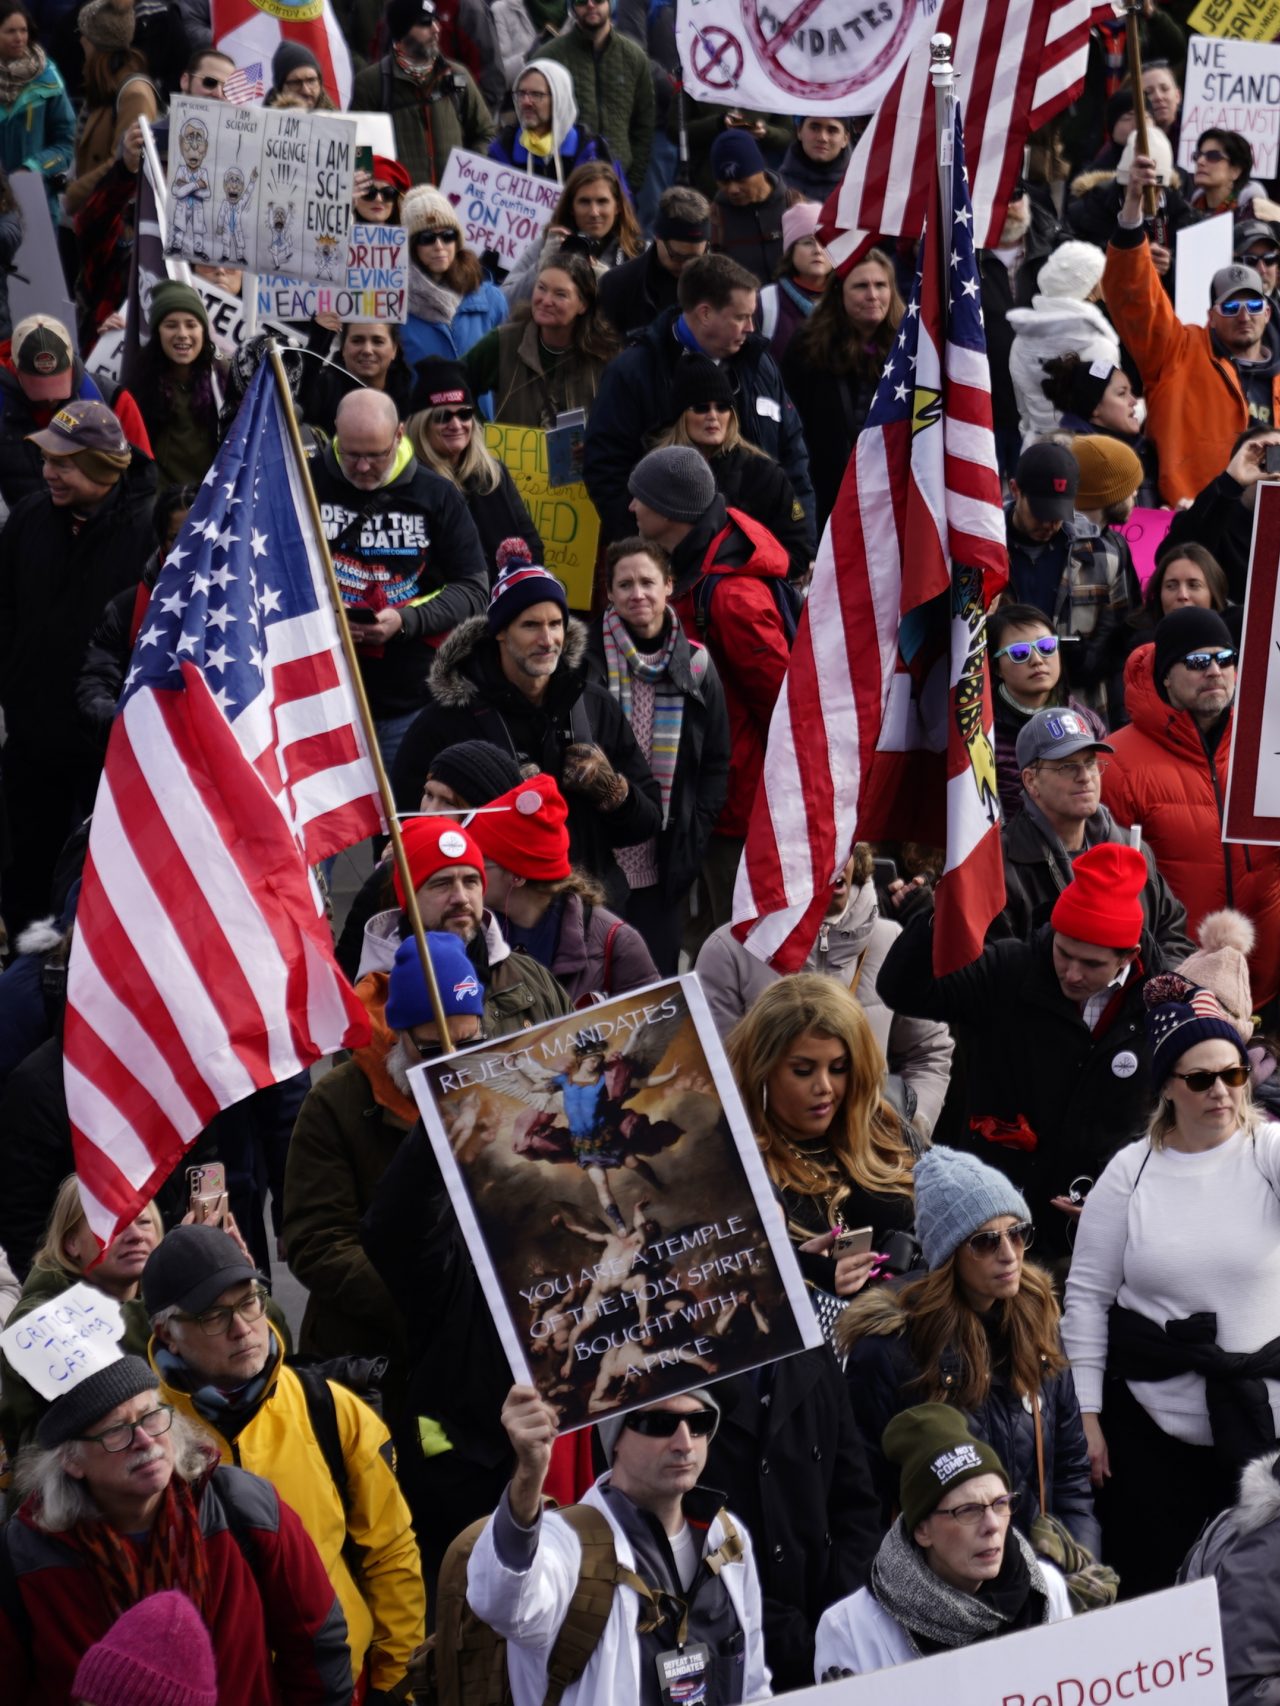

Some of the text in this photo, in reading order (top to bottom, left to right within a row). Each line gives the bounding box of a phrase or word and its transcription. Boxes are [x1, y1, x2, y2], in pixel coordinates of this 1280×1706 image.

[757, 1, 895, 58] MNDATES
[1191, 43, 1227, 69] WE
[240, 110, 250, 121] AM
[278, 117, 300, 137] I AM
[265, 140, 306, 164] SCIENCE
[315, 139, 349, 172] I AM
[315, 171, 347, 200] SCI-
[496, 172, 561, 210] CHILDRE
[307, 202, 350, 236] ENCE!
[468, 200, 500, 229] ON
[353, 226, 407, 245] EVING
[465, 223, 518, 259] SPEAK
[348, 269, 403, 288] EVING
[275, 290, 331, 317] EACH
[336, 289, 405, 320] OTHER!
[321, 522, 431, 549] MDATES
[388, 512, 425, 534] THE
[1044, 714, 1092, 740] USA
[438, 998, 678, 1095] REJECT MANDATES
[518, 1215, 748, 1305] YOU ARE A TEMPLE
[528, 1249, 762, 1340] OF THE HOLY SPIRIT,
[15, 1299, 95, 1350] CRITICAL
[572, 1290, 740, 1363] BOUGHT WITH
[623, 1337, 713, 1382] A PRICE
[934, 1452, 956, 1468] WILL
[954, 1445, 975, 1456] NOT
[936, 1452, 981, 1480] COMPLY.
[663, 1653, 703, 1671] DEFEAT THE
[664, 1661, 705, 1679] MANDATES
